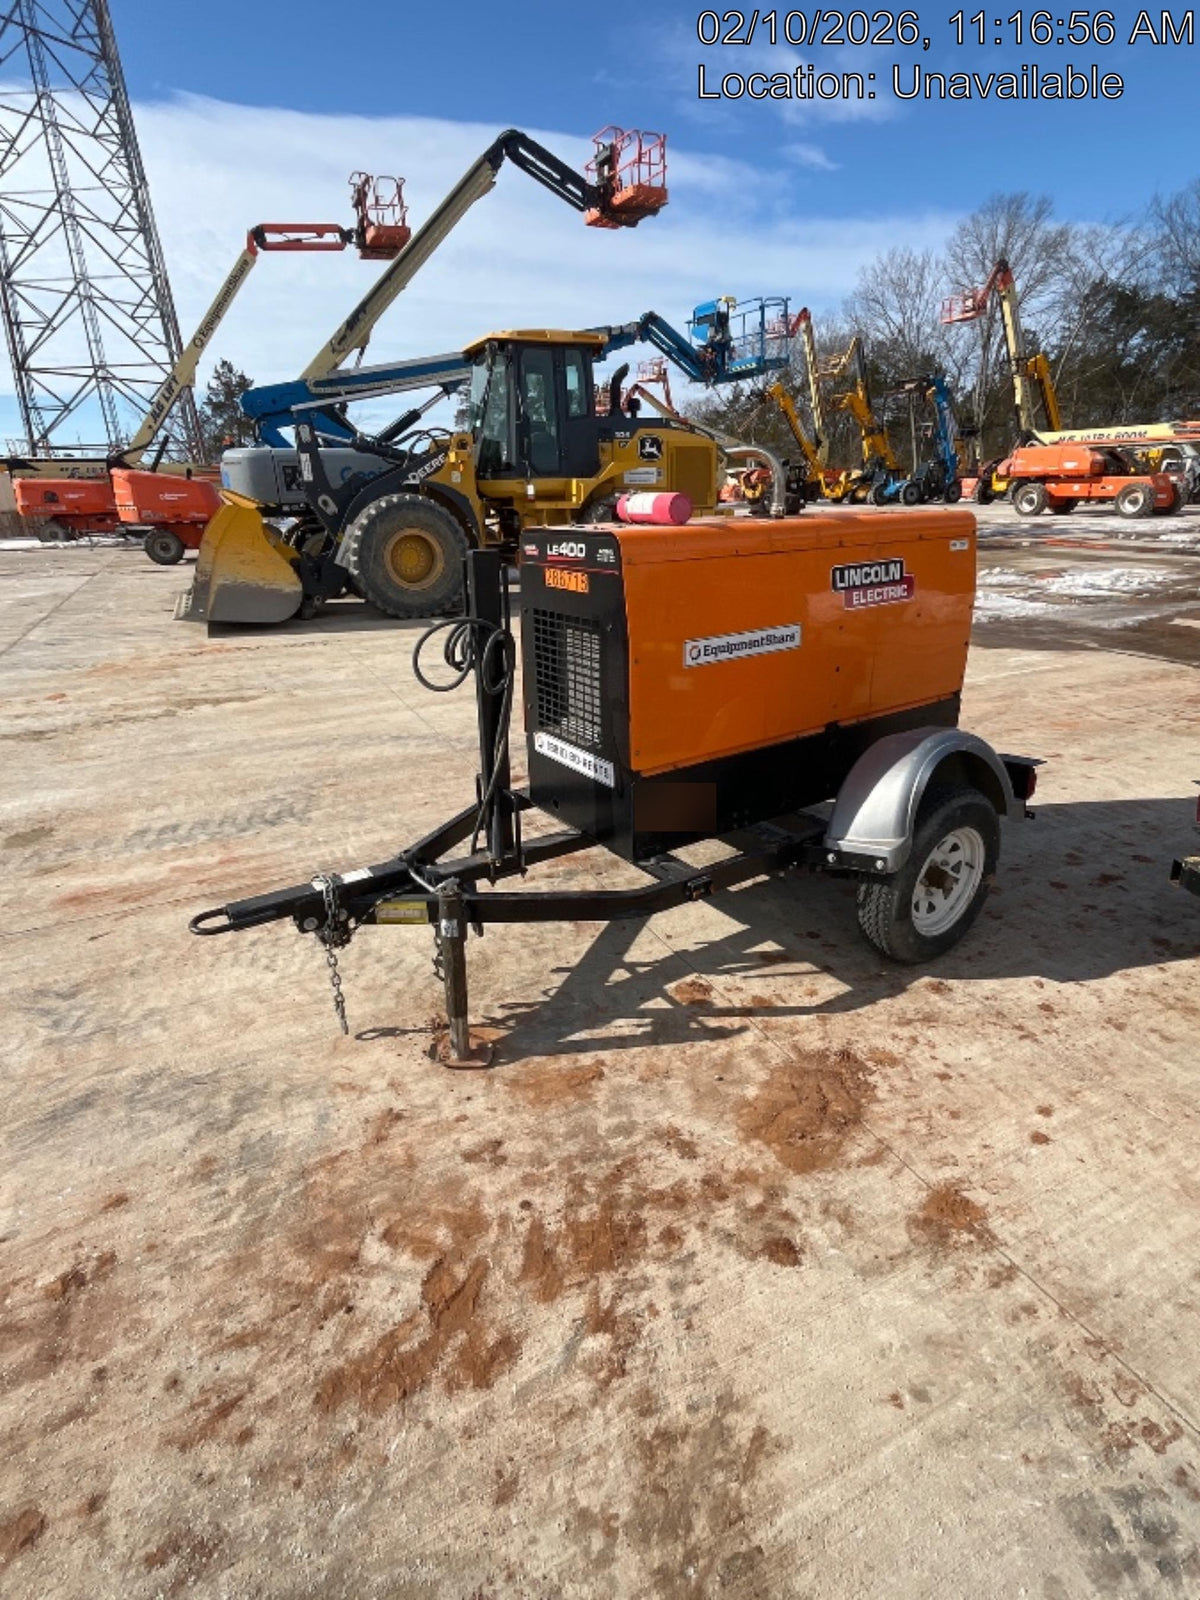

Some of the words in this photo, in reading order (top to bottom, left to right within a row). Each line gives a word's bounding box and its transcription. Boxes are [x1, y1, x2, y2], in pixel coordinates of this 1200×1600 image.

[408, 453, 446, 482] DEERE
[547, 542, 586, 558] LE400
[836, 563, 901, 588] LINCOLN
[852, 584, 908, 605] ELECTRIC
[703, 633, 796, 657] EquipmentShare
